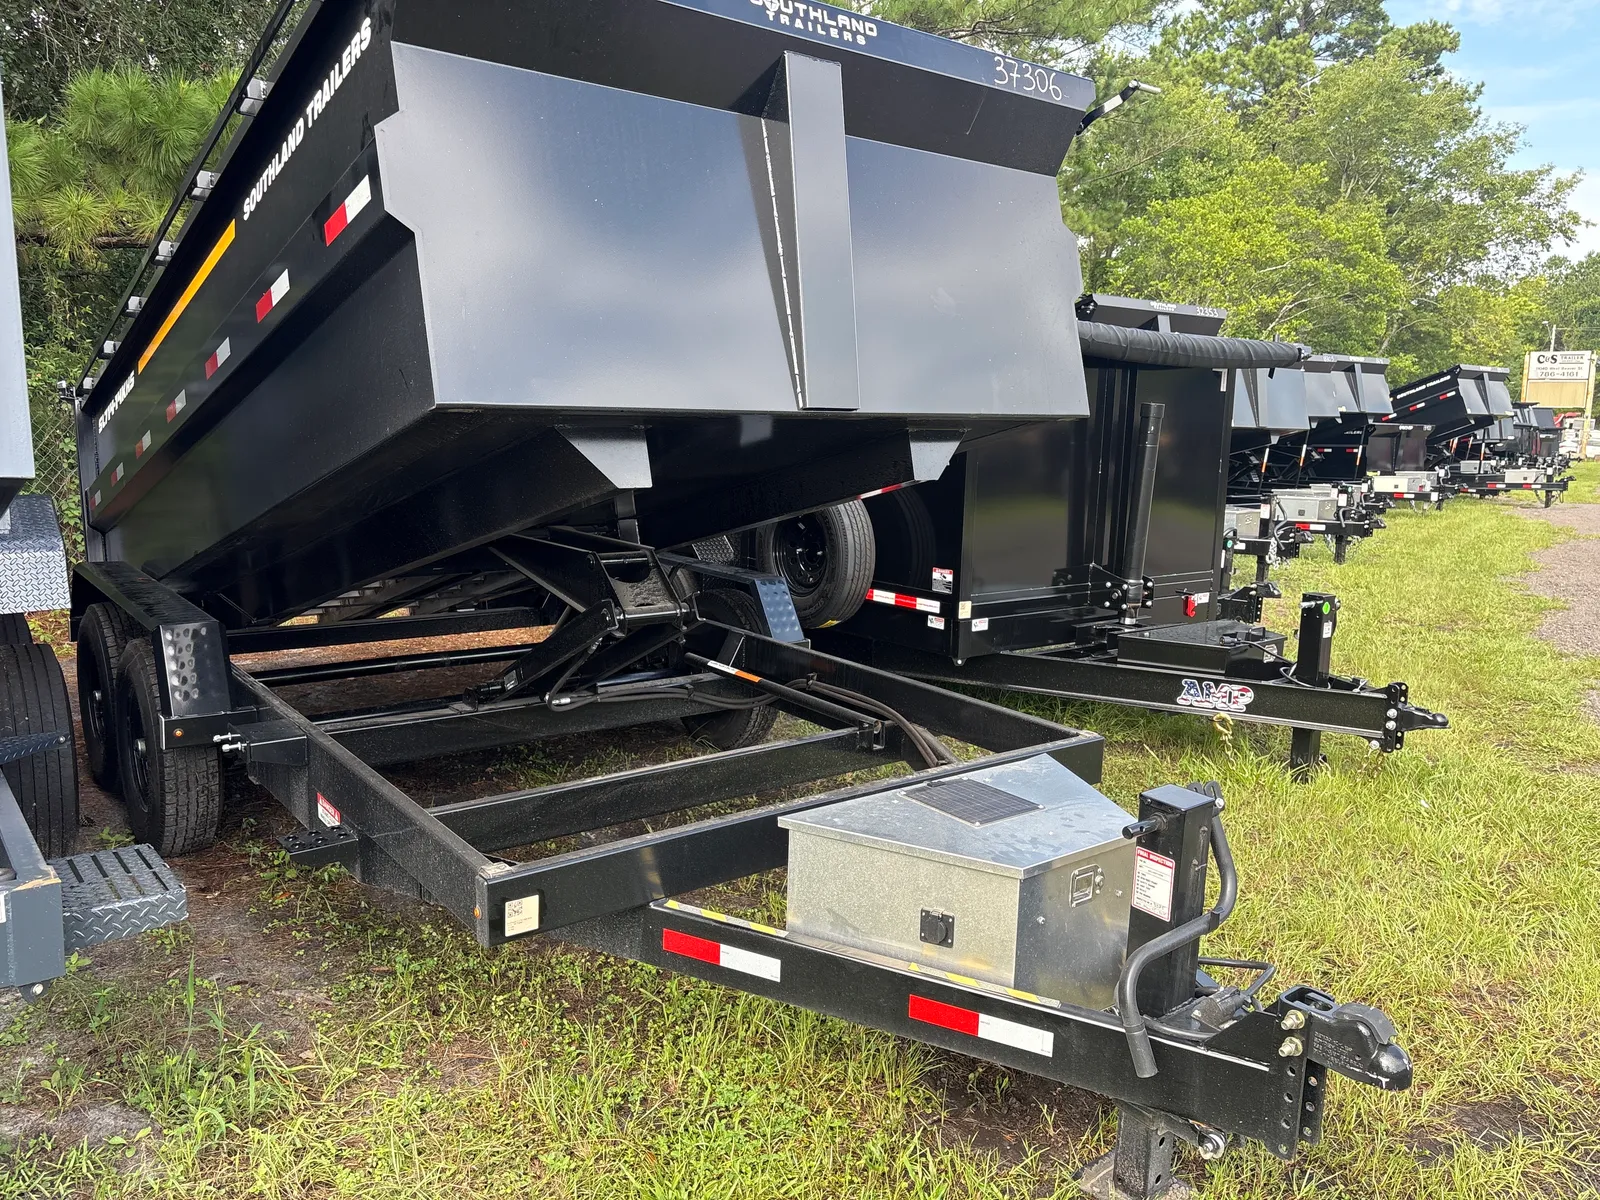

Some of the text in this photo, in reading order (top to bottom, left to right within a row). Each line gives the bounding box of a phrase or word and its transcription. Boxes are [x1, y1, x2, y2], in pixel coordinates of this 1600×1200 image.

[766, 10, 866, 45] TRAILERS
[994, 56, 1062, 101] 37306
[243, 17, 372, 221] SOUTHLAND TRAILERS
[1196, 306, 1218, 318] 32353
[1537, 354, 1558, 364] C&S
[1177, 679, 1254, 713] AMP
